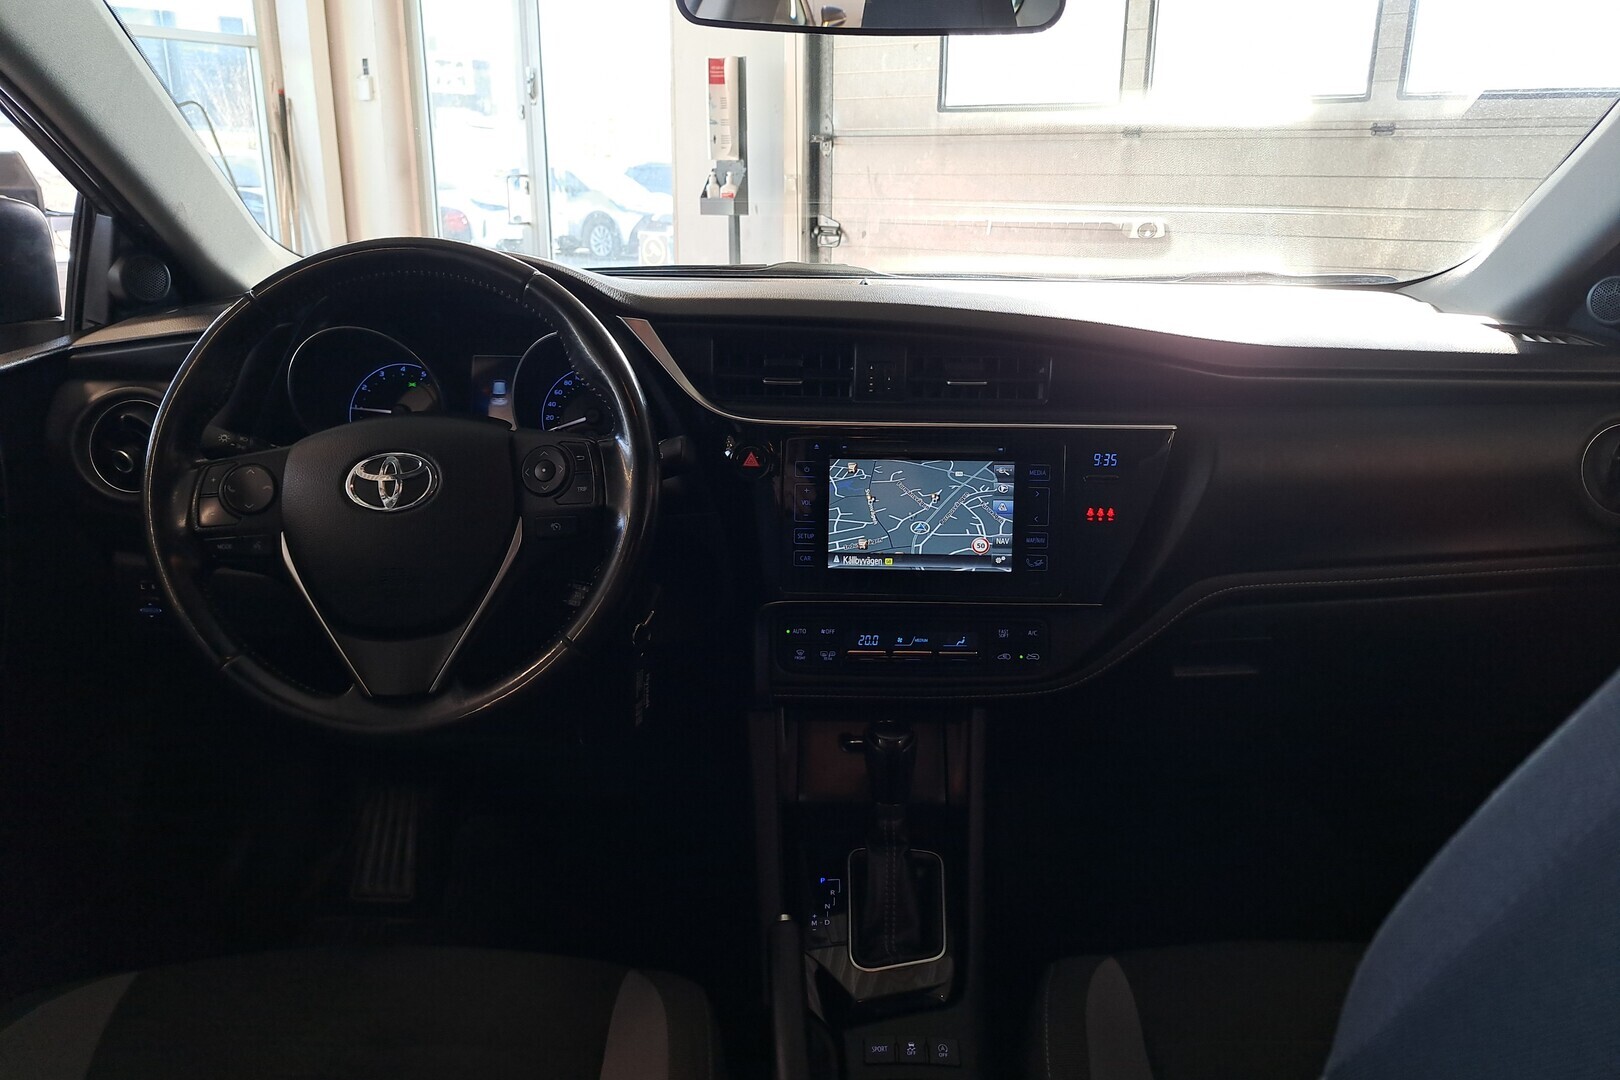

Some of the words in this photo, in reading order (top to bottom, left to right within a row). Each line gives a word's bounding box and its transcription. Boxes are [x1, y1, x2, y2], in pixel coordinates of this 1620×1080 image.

[1093, 453, 1117, 467] 9:35
[797, 532, 815, 540] SETUP
[995, 537, 1010, 545] NAV
[799, 554, 812, 562] CAR
[857, 634, 879, 646] 20.0
[871, 1045, 888, 1053] SPORT
